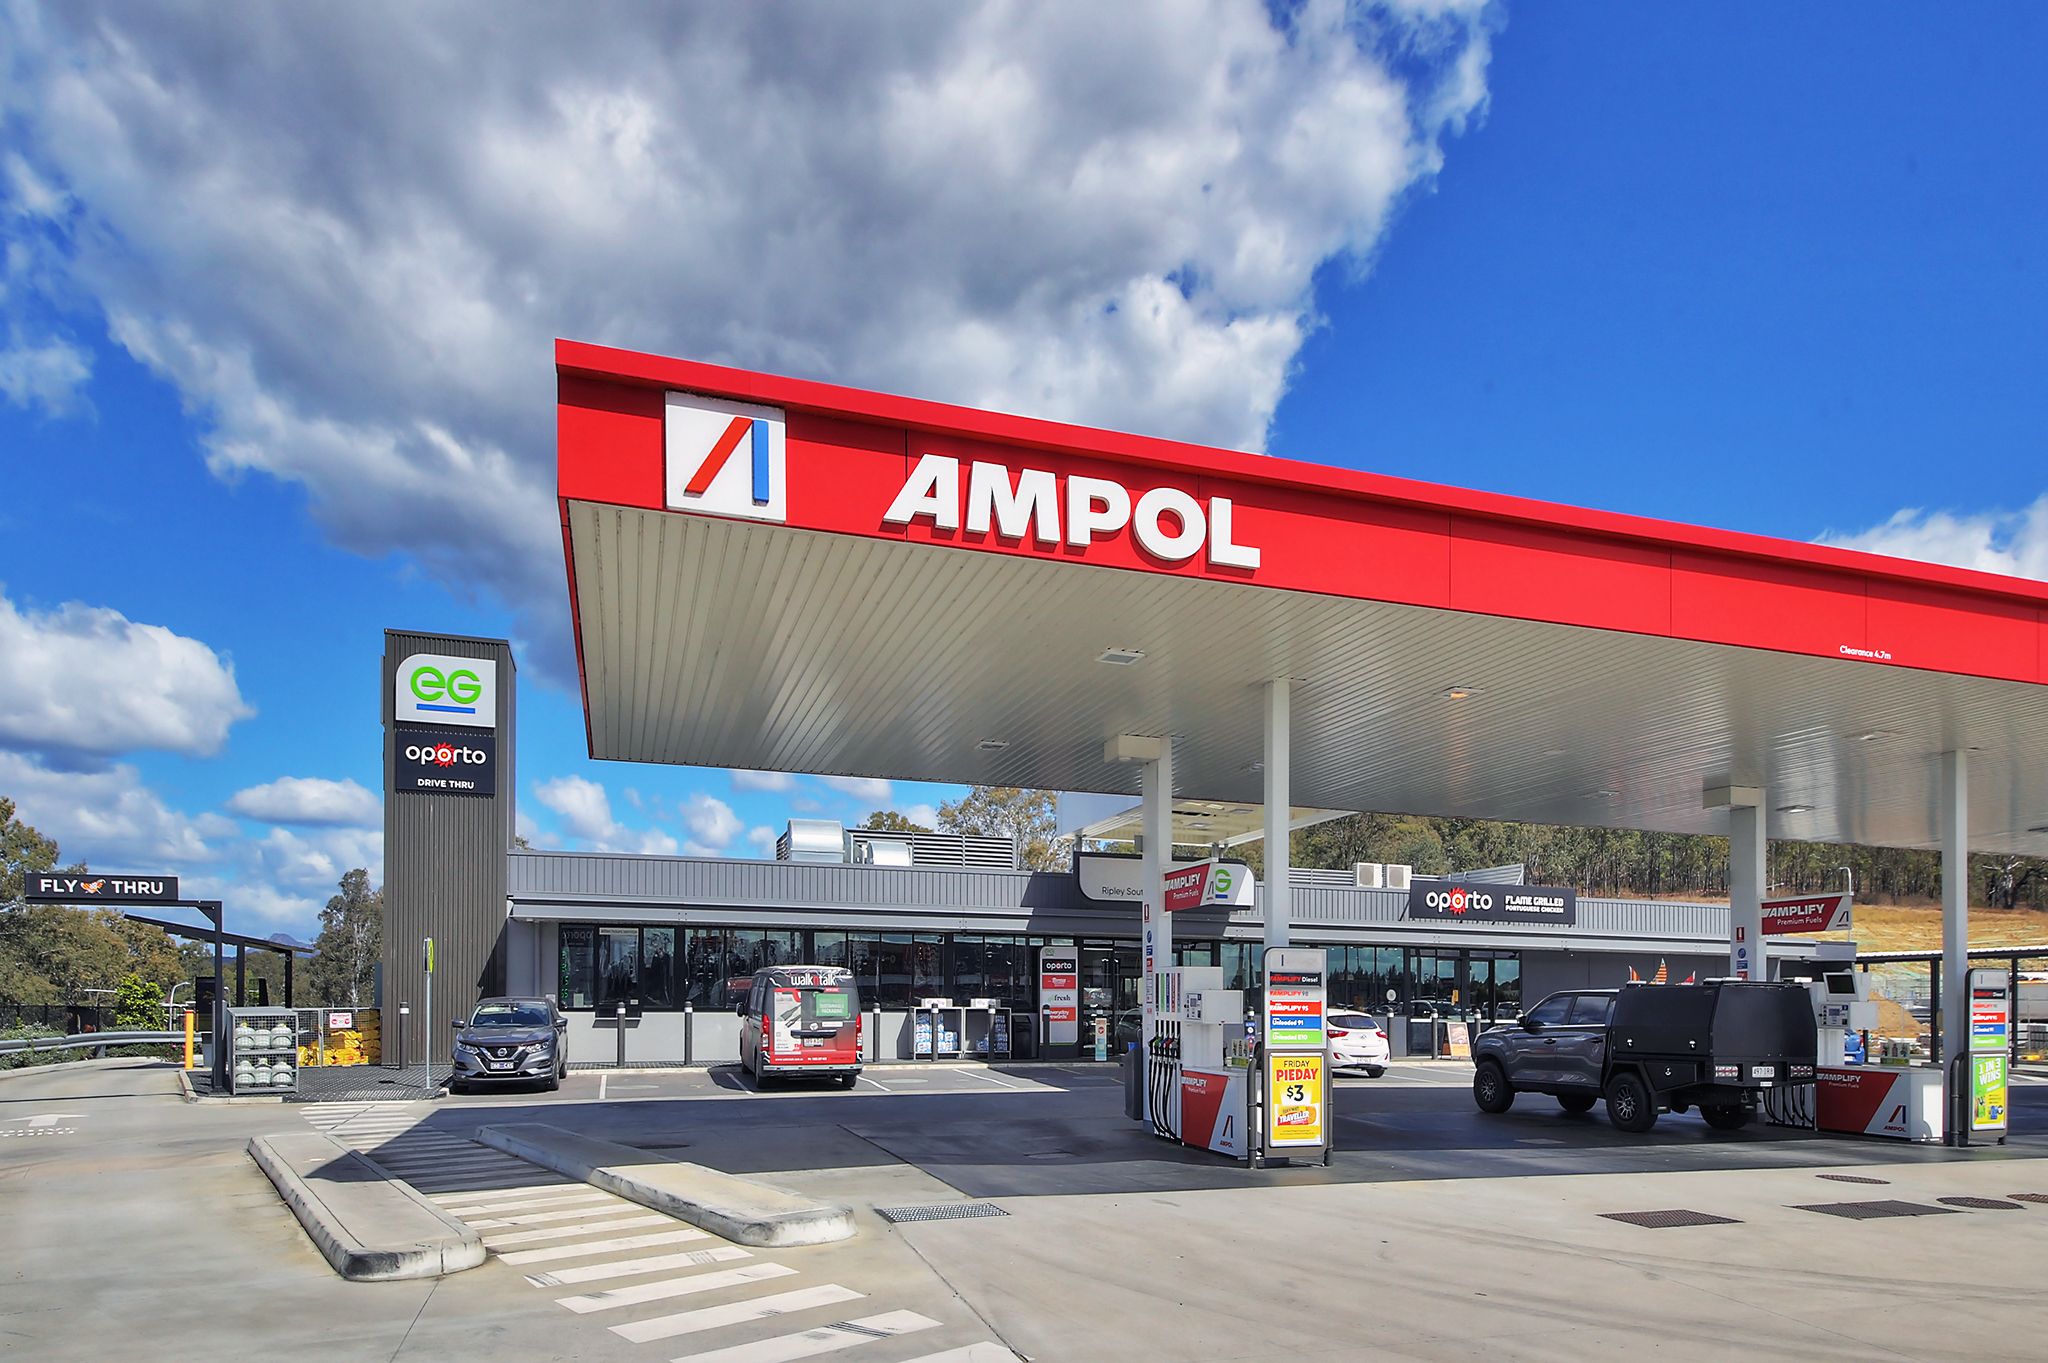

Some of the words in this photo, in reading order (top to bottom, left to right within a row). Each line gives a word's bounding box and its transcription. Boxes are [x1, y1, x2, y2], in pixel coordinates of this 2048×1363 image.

[882, 453, 1261, 570] AMPOL
[1839, 645, 1873, 657] Clearance
[405, 745, 487, 765] oporto
[417, 778, 447, 788] DRIVE
[449, 780, 475, 789] THRU
[39, 879, 78, 893] FLY
[111, 881, 164, 895] THRU
[1168, 873, 1201, 890] AMPLIFY
[1216, 869, 1232, 893] G
[1101, 886, 1125, 897] Ripley
[1126, 887, 1144, 896] Sout
[1425, 889, 1493, 913] oporto
[1505, 895, 1532, 905] FLAME
[1533, 897, 1564, 907] GRILLED
[1769, 903, 1825, 918] AMPLIFY
[1777, 918, 1805, 926] Premium
[1805, 916, 1823, 924] Fuels
[1046, 962, 1072, 971] oporto
[1283, 1060, 1310, 1068] FRIDAY
[1276, 1068, 1319, 1082] PIEDAY
[1821, 1073, 1862, 1083] AMPLIFY
[1979, 1069, 2001, 1086] WINS
[1286, 1084, 1304, 1102] $3
[1884, 1125, 1907, 1133] AMPOL
